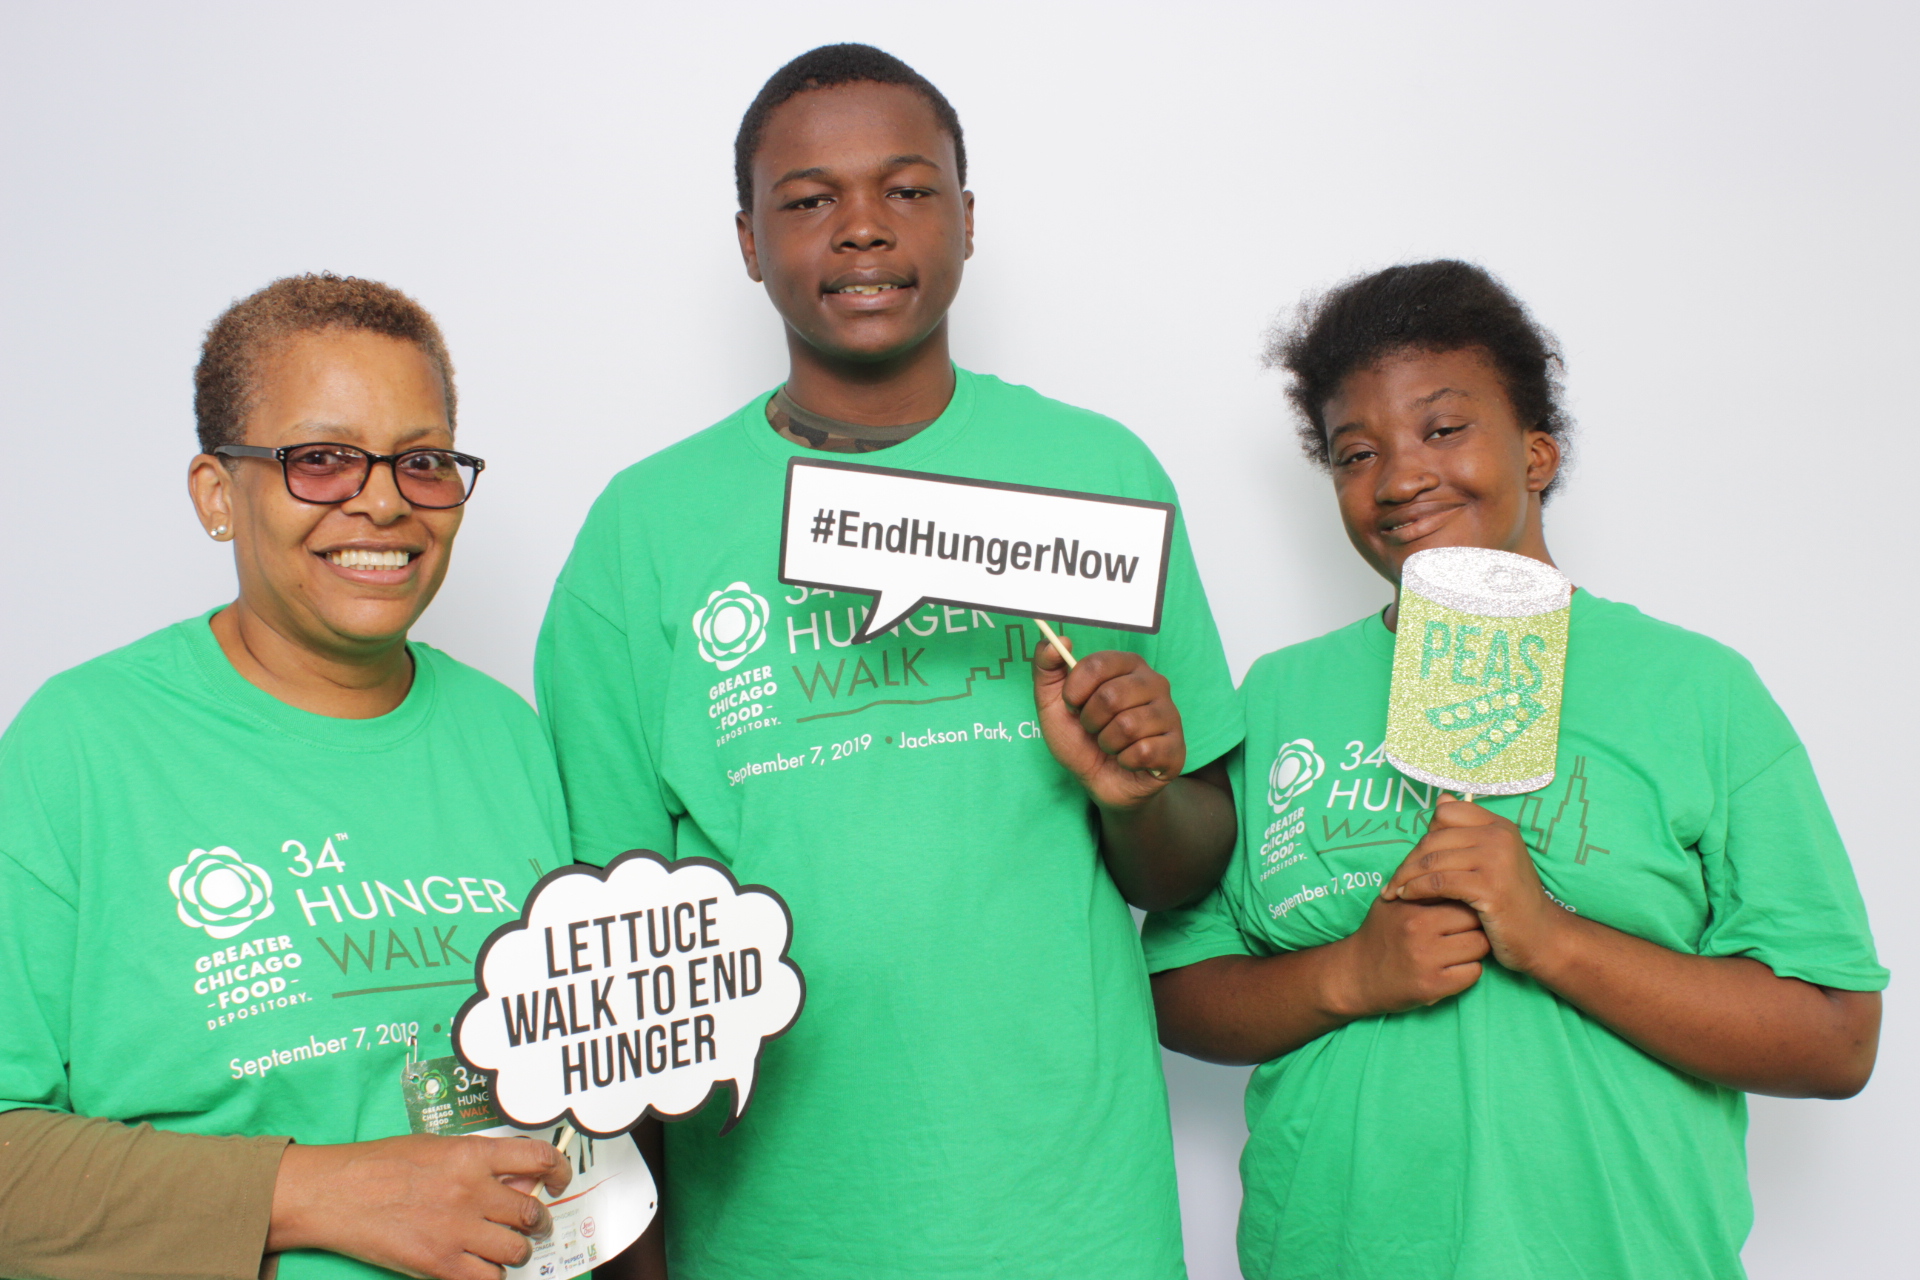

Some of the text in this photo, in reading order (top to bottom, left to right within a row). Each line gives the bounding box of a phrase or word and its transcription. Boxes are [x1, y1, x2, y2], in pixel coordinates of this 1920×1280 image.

[811, 508, 1139, 583] #EndHungerNow
[792, 648, 930, 703] WALK
[1420, 620, 1547, 694] PEAS
[708, 681, 778, 719] CHICAGO
[709, 665, 772, 700] GREATER
[898, 727, 968, 749] Jackson
[973, 721, 1012, 742] Park,
[727, 733, 873, 787] September 7, 2019
[1260, 820, 1306, 856] CHICAGO
[1264, 806, 1305, 840] GREATER
[295, 875, 520, 927] HUNGER
[1268, 871, 1383, 919] September 7, 2019
[195, 935, 294, 973] GREATER
[316, 925, 473, 976] WALK
[544, 896, 720, 979] LETTUCE
[193, 953, 303, 995] CHICAGO
[501, 947, 762, 1048] WALK TO END
[229, 1035, 348, 1080] September
[352, 1027, 372, 1051] 7,
[375, 1021, 420, 1046] 2019
[561, 1013, 717, 1096] HUNGER
[422, 1103, 452, 1115] GREATER
[422, 1110, 454, 1122] CHICAGO
[428, 1117, 450, 1128] FOOD
[460, 1105, 490, 1119] WALK
